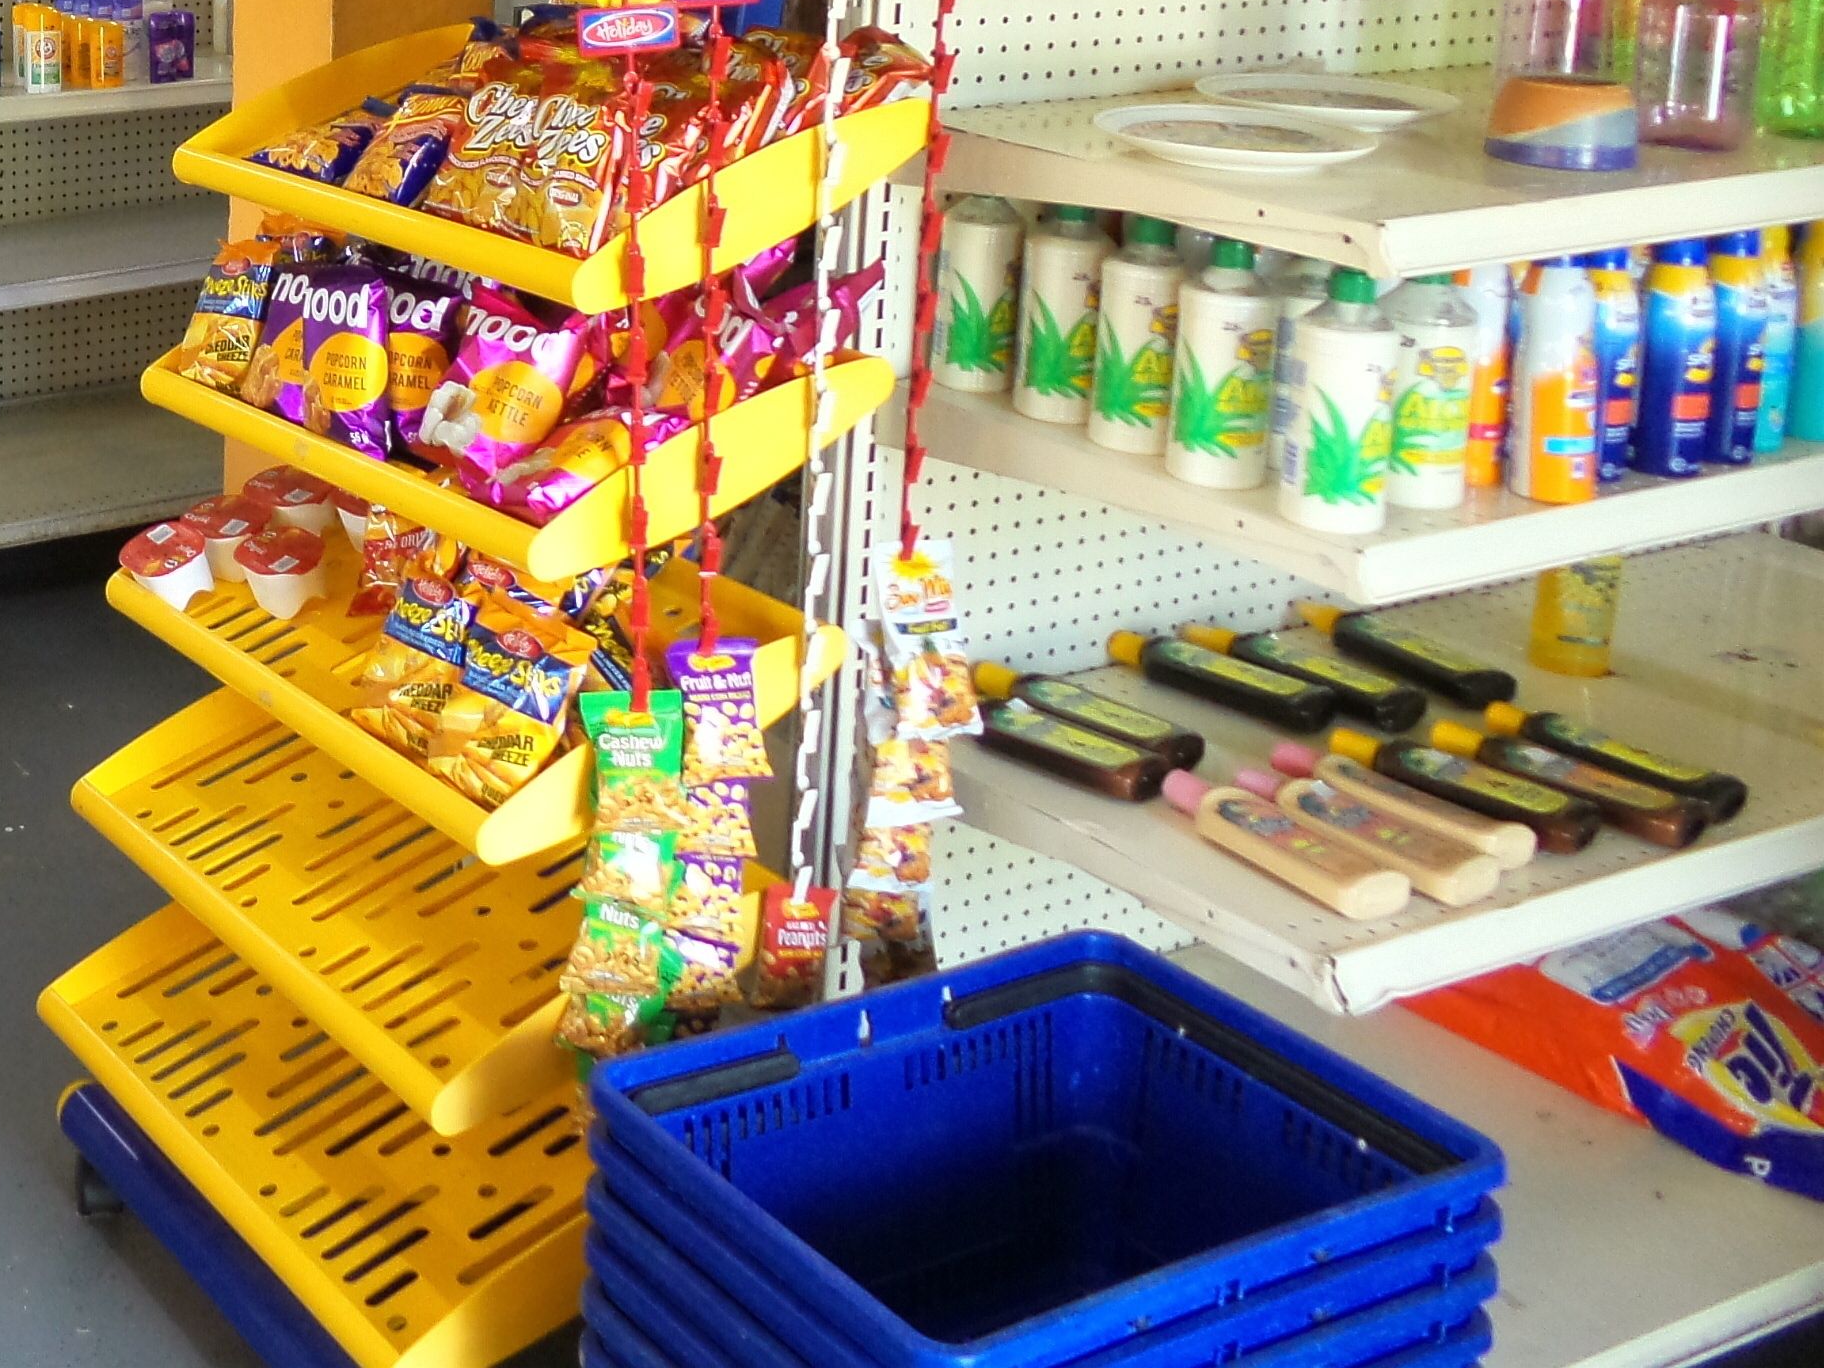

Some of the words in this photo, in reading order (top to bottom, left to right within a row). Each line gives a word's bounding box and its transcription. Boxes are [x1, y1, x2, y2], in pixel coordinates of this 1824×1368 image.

[596, 16, 654, 39] Holiday
[272, 272, 309, 304] no
[326, 352, 367, 370] POPCORN
[323, 372, 367, 391] CARAMEL
[493, 375, 544, 410] POPCORN
[487, 396, 529, 427] KETTLE
[680, 673, 712, 692] Fruit
[598, 733, 665, 751] Cashew
[610, 749, 652, 768] Nuts
[601, 902, 640, 930] Nuts
[778, 928, 827, 948] Peanuts
